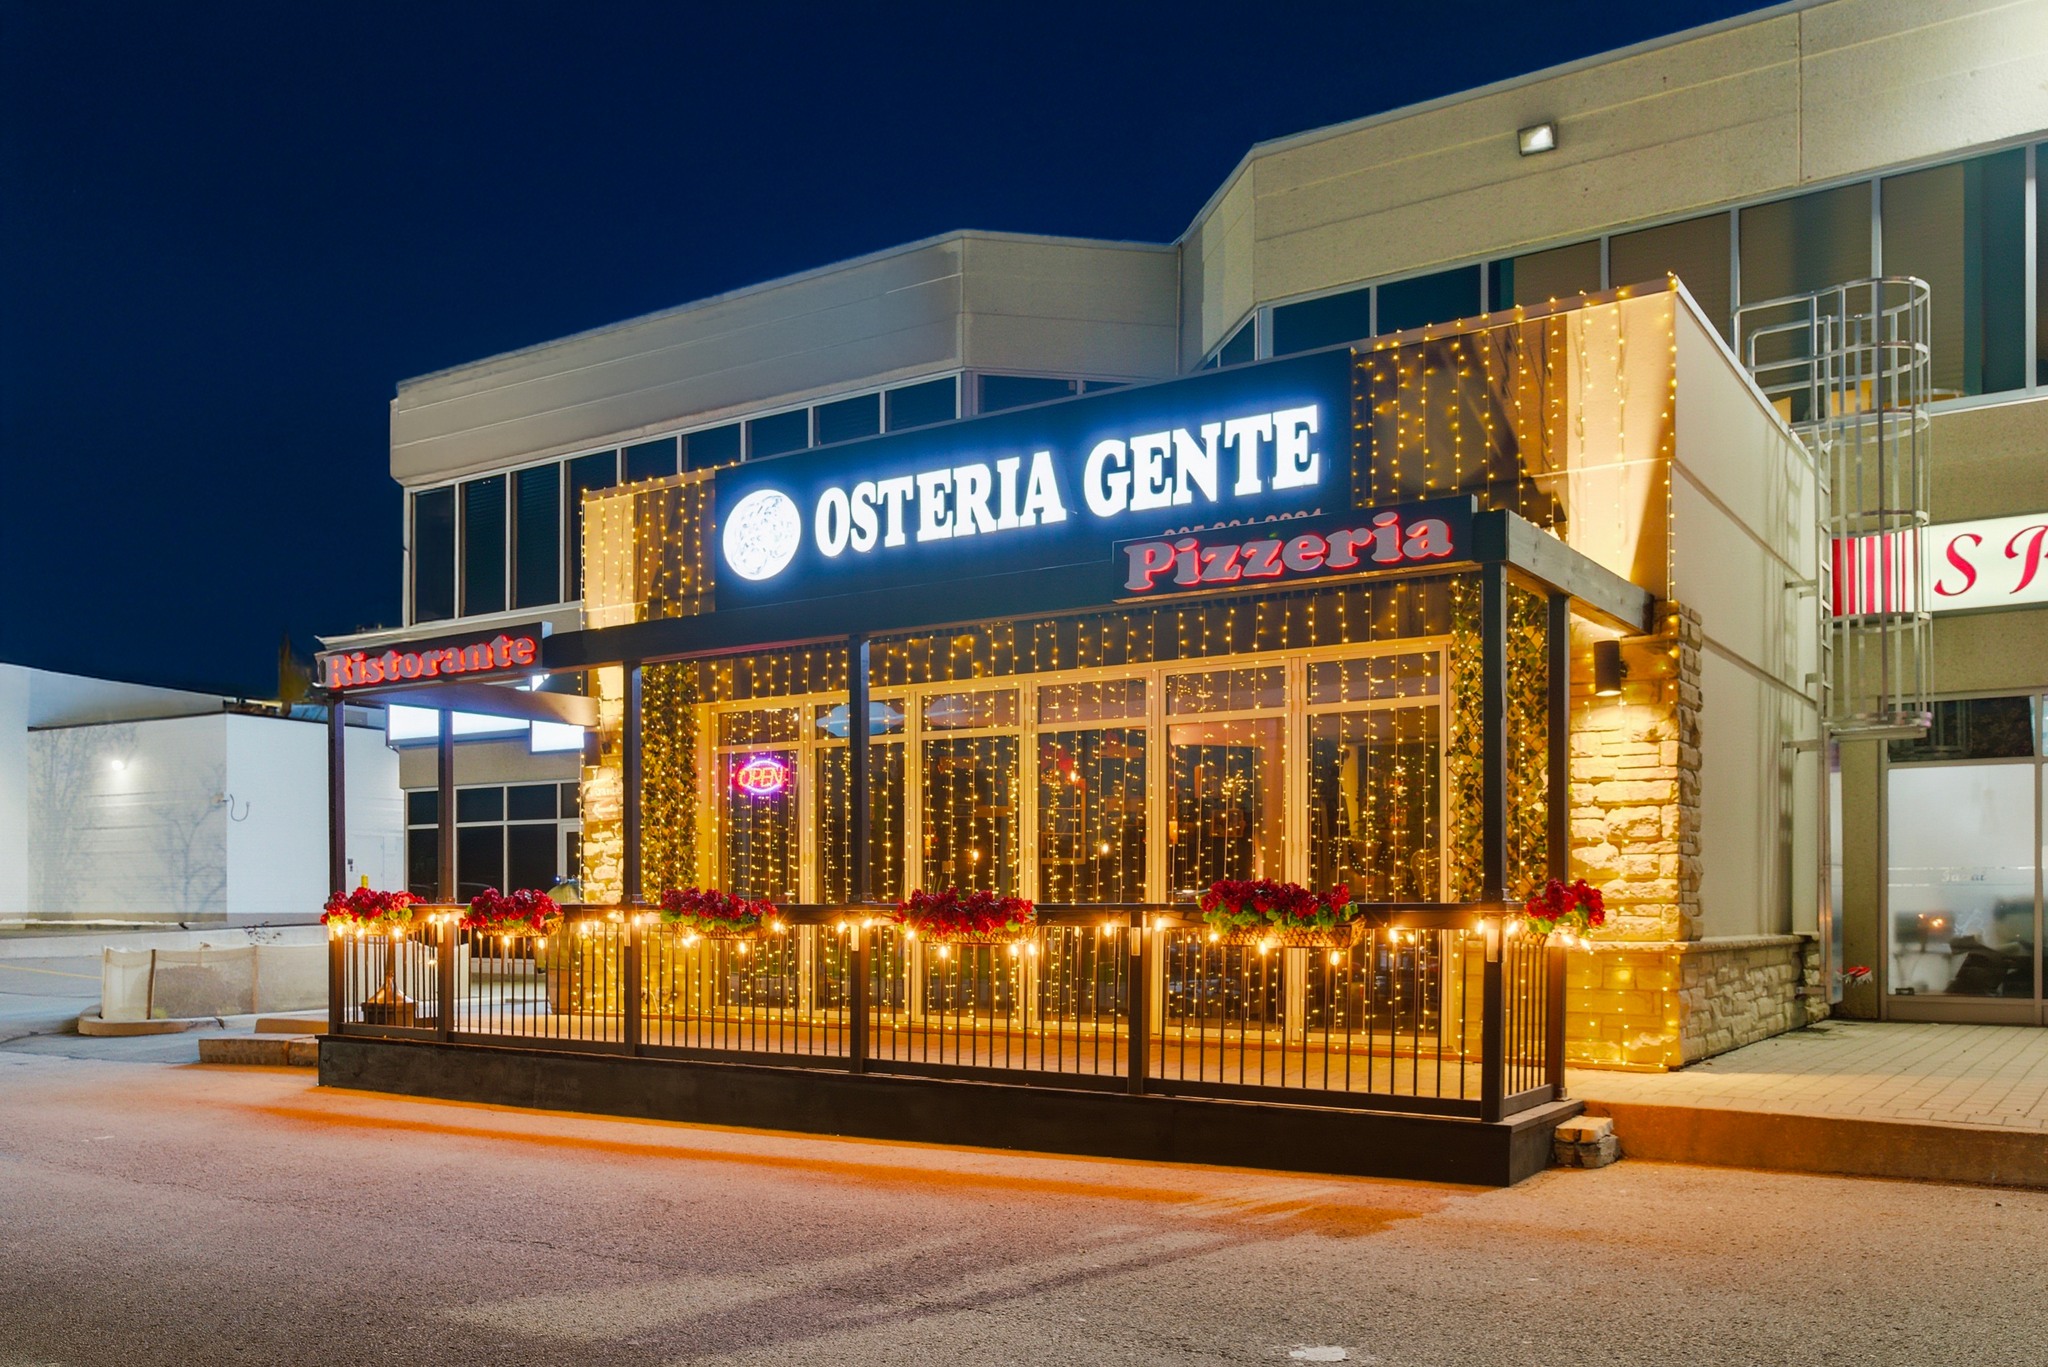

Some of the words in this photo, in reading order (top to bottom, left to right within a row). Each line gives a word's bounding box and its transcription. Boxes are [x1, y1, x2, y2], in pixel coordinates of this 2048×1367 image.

[814, 450, 1067, 559] OSTERIA
[1083, 403, 1321, 518] GENTE
[1124, 511, 1453, 592] Pizzeria
[325, 634, 536, 689] Ristorante
[739, 766, 784, 788] OPEN
